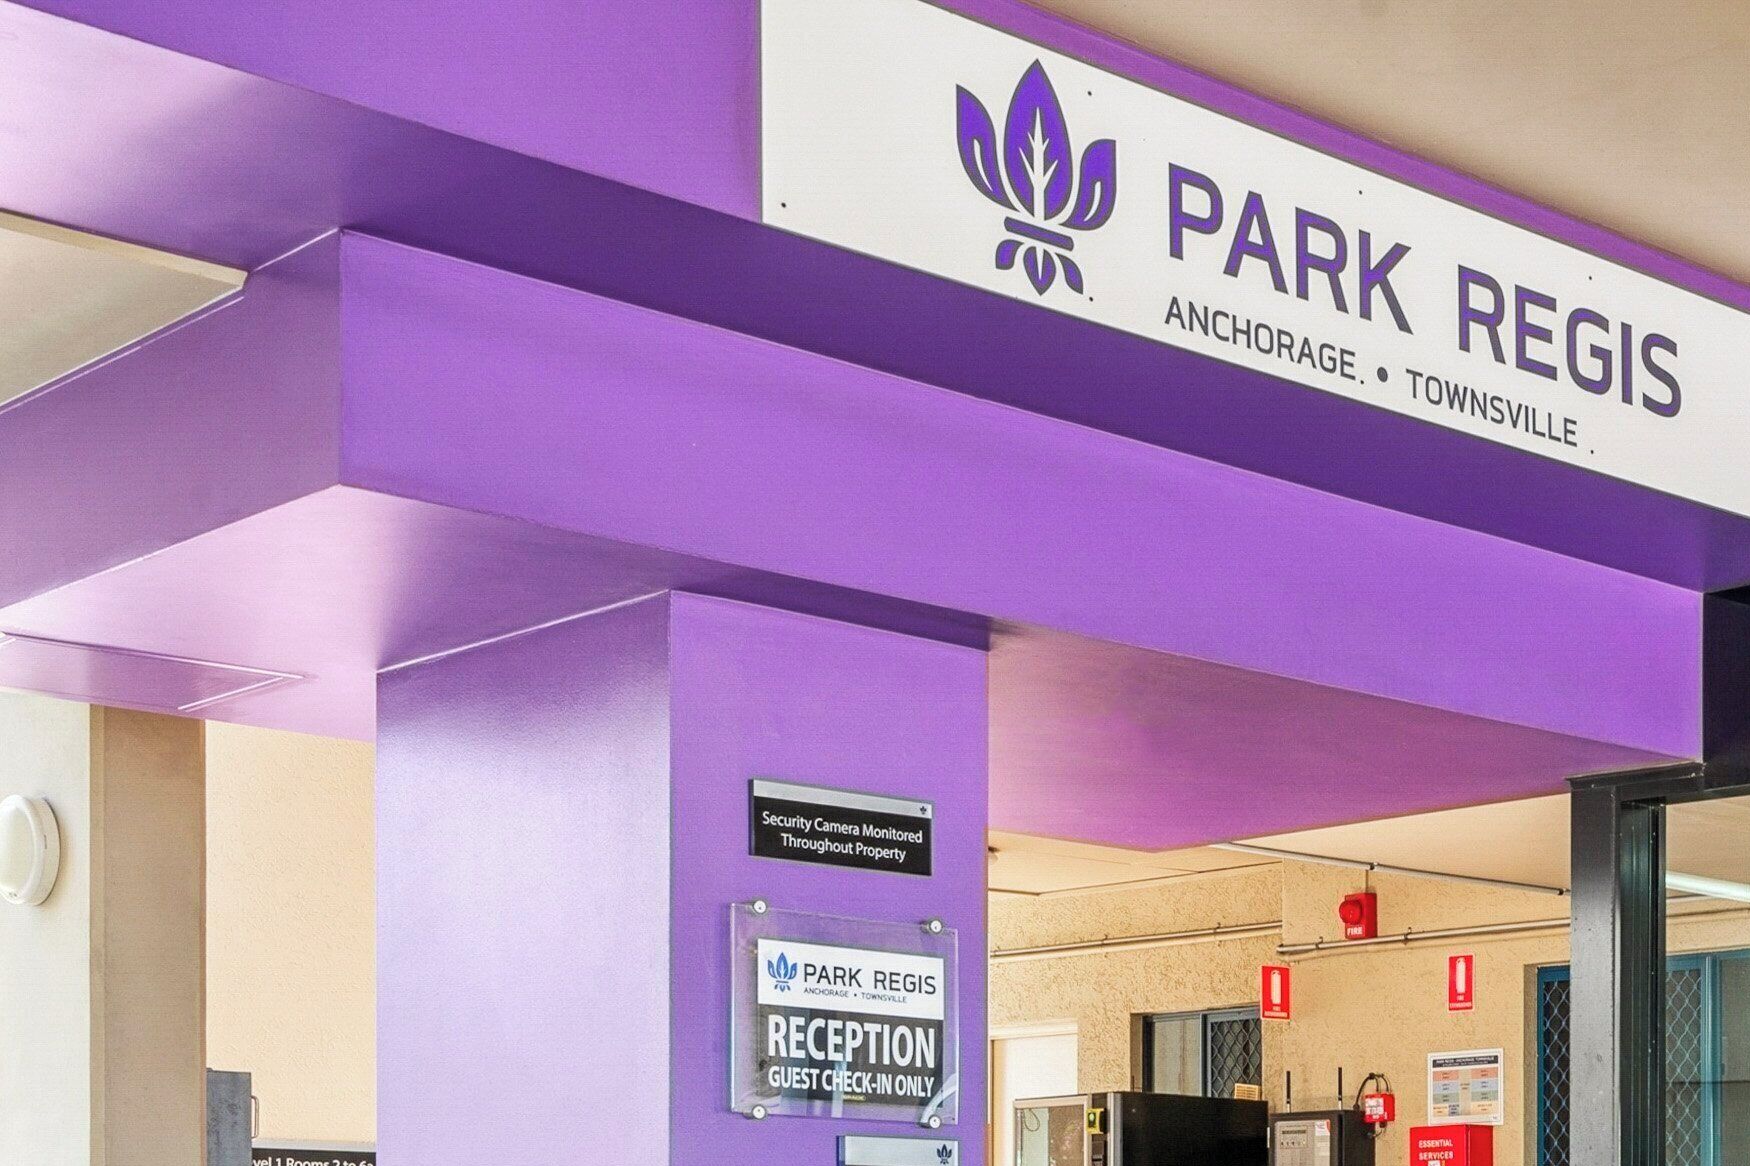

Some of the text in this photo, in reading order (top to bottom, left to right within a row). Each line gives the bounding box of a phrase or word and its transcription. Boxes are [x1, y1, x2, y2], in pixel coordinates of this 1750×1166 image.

[1166, 162, 1684, 420] PARK REGIS
[1164, 295, 1579, 448] ANCHORAGE TOWNSVILLE
[762, 810, 923, 843] Security Camera Monitored
[780, 833, 906, 863] Throughout Property
[803, 963, 936, 995] PARK REGIS
[803, 987, 907, 1003] ANCHORAGE TOWNSVILLE
[767, 1014, 935, 1069] RECEPTION
[767, 1065, 935, 1098] GUEST CHECK-IN ONLY
[1418, 1139, 1453, 1149] ESSENTIAL
[1418, 1151, 1454, 1161] SERVICES
